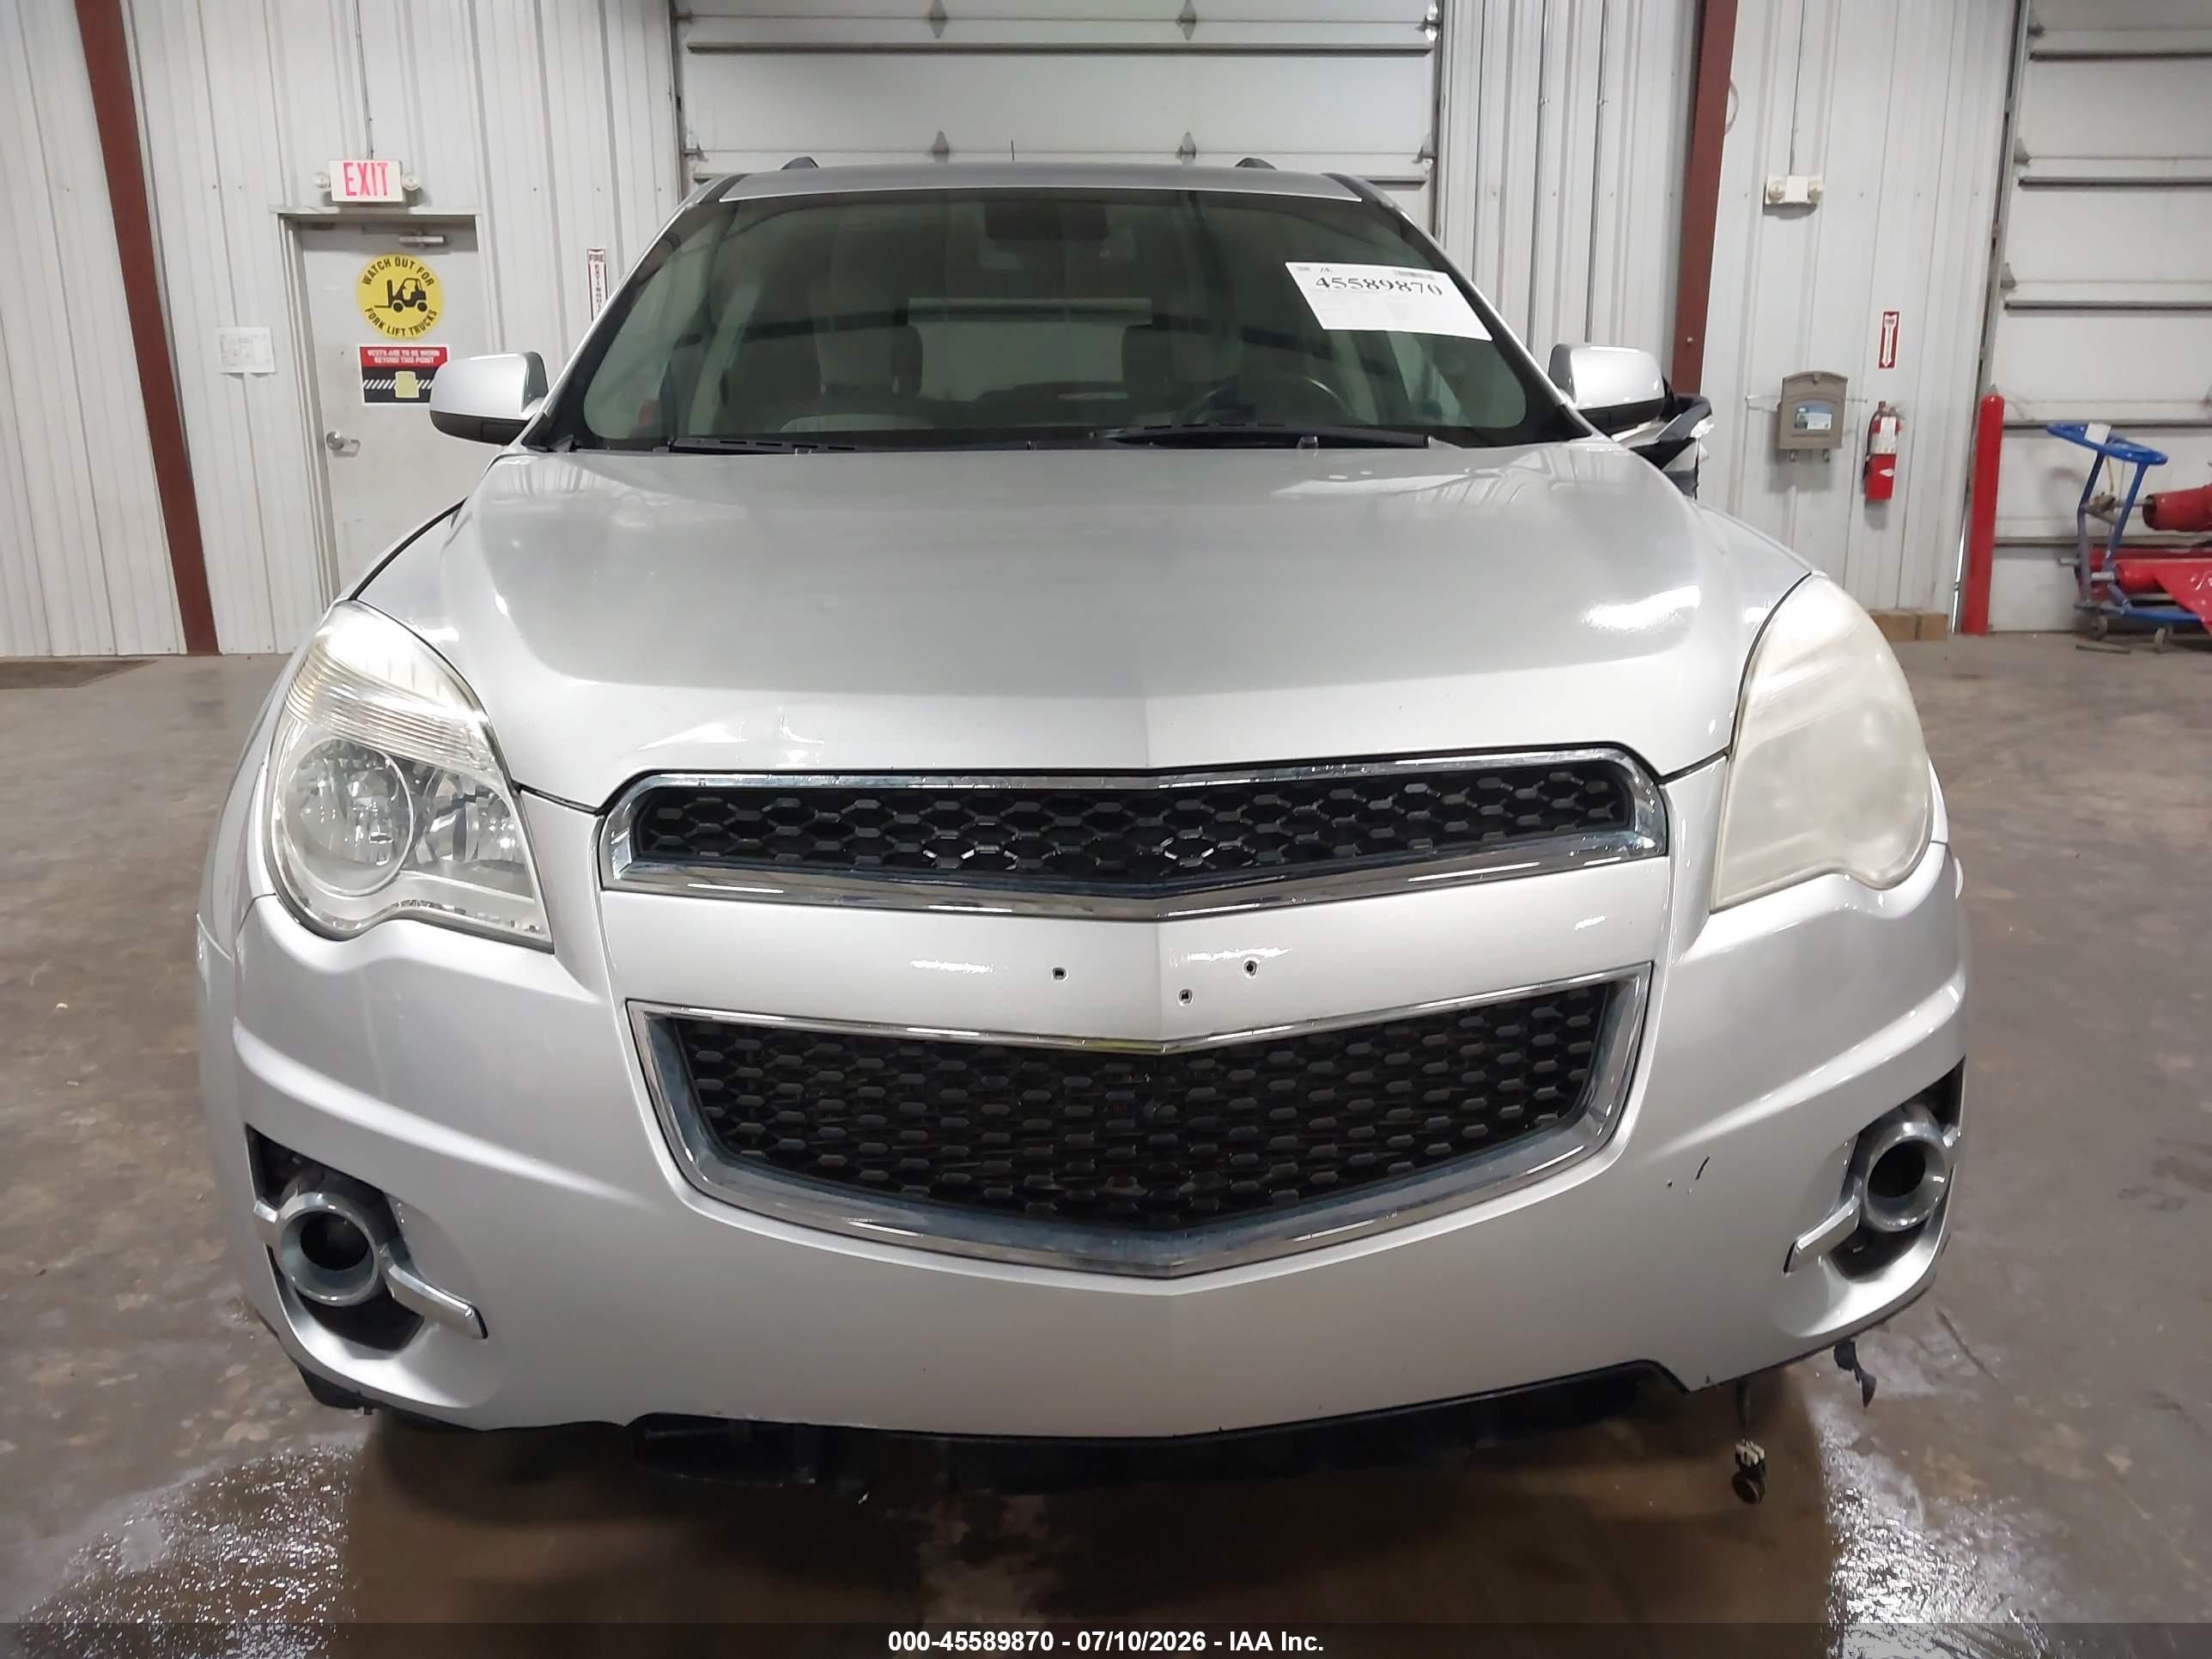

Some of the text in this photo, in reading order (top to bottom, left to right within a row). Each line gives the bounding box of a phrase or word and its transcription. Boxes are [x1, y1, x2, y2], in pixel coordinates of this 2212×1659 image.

[343, 162, 388, 197] EXIT
[362, 257, 434, 287] WATCH OUT FOR
[1316, 276, 1443, 295] 45589870
[365, 307, 437, 337] FORK LIFT TRUCKS
